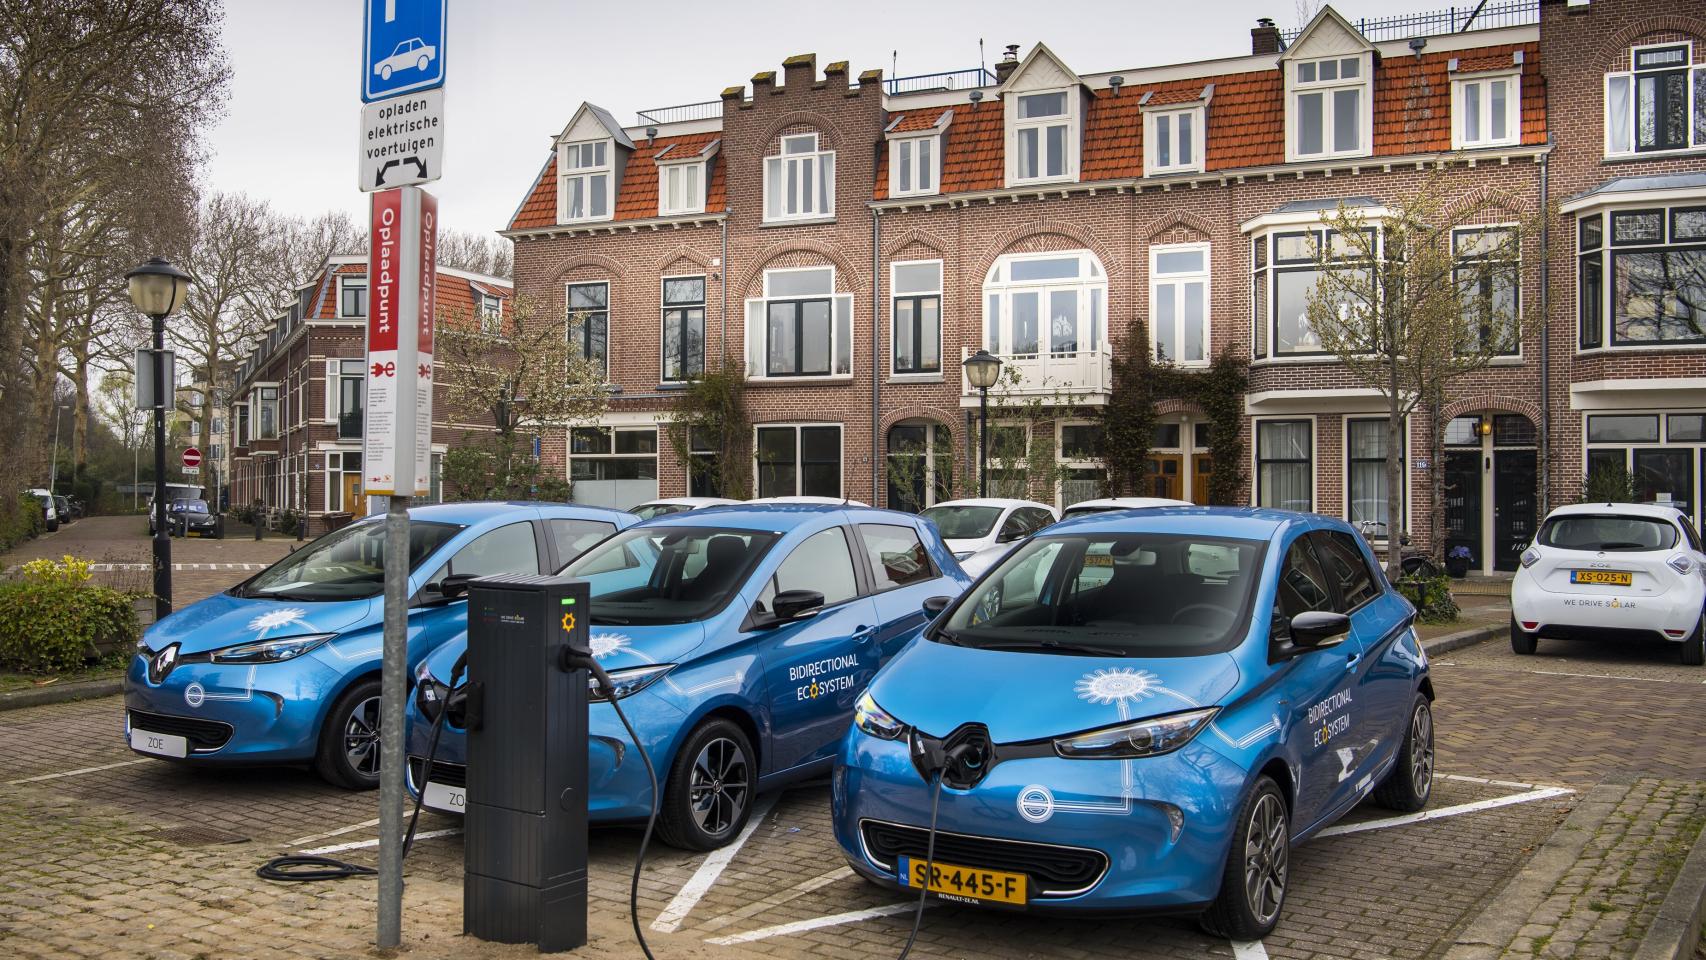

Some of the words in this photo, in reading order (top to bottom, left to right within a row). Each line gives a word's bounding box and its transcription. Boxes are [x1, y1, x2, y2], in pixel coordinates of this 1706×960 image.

[379, 100, 427, 120] opladen
[368, 116, 438, 140] elektrische
[367, 136, 434, 159] voertuigen
[378, 208, 394, 333] Oplaadpunt
[422, 212, 433, 336] Oplaadpunt
[1580, 573, 1628, 582] XS-025-N
[789, 654, 859, 681] BIDIRECTIONAL
[797, 674, 854, 701] ECOSYSTEM
[1308, 688, 1352, 724] BIDIRECTIONAL
[148, 737, 164, 749] ZOE
[449, 792, 465, 807] ZO
[900, 873, 908, 881] NL
[915, 864, 1017, 899] SR-445-F
[938, 893, 980, 905] RENAULT-ZE.NL
